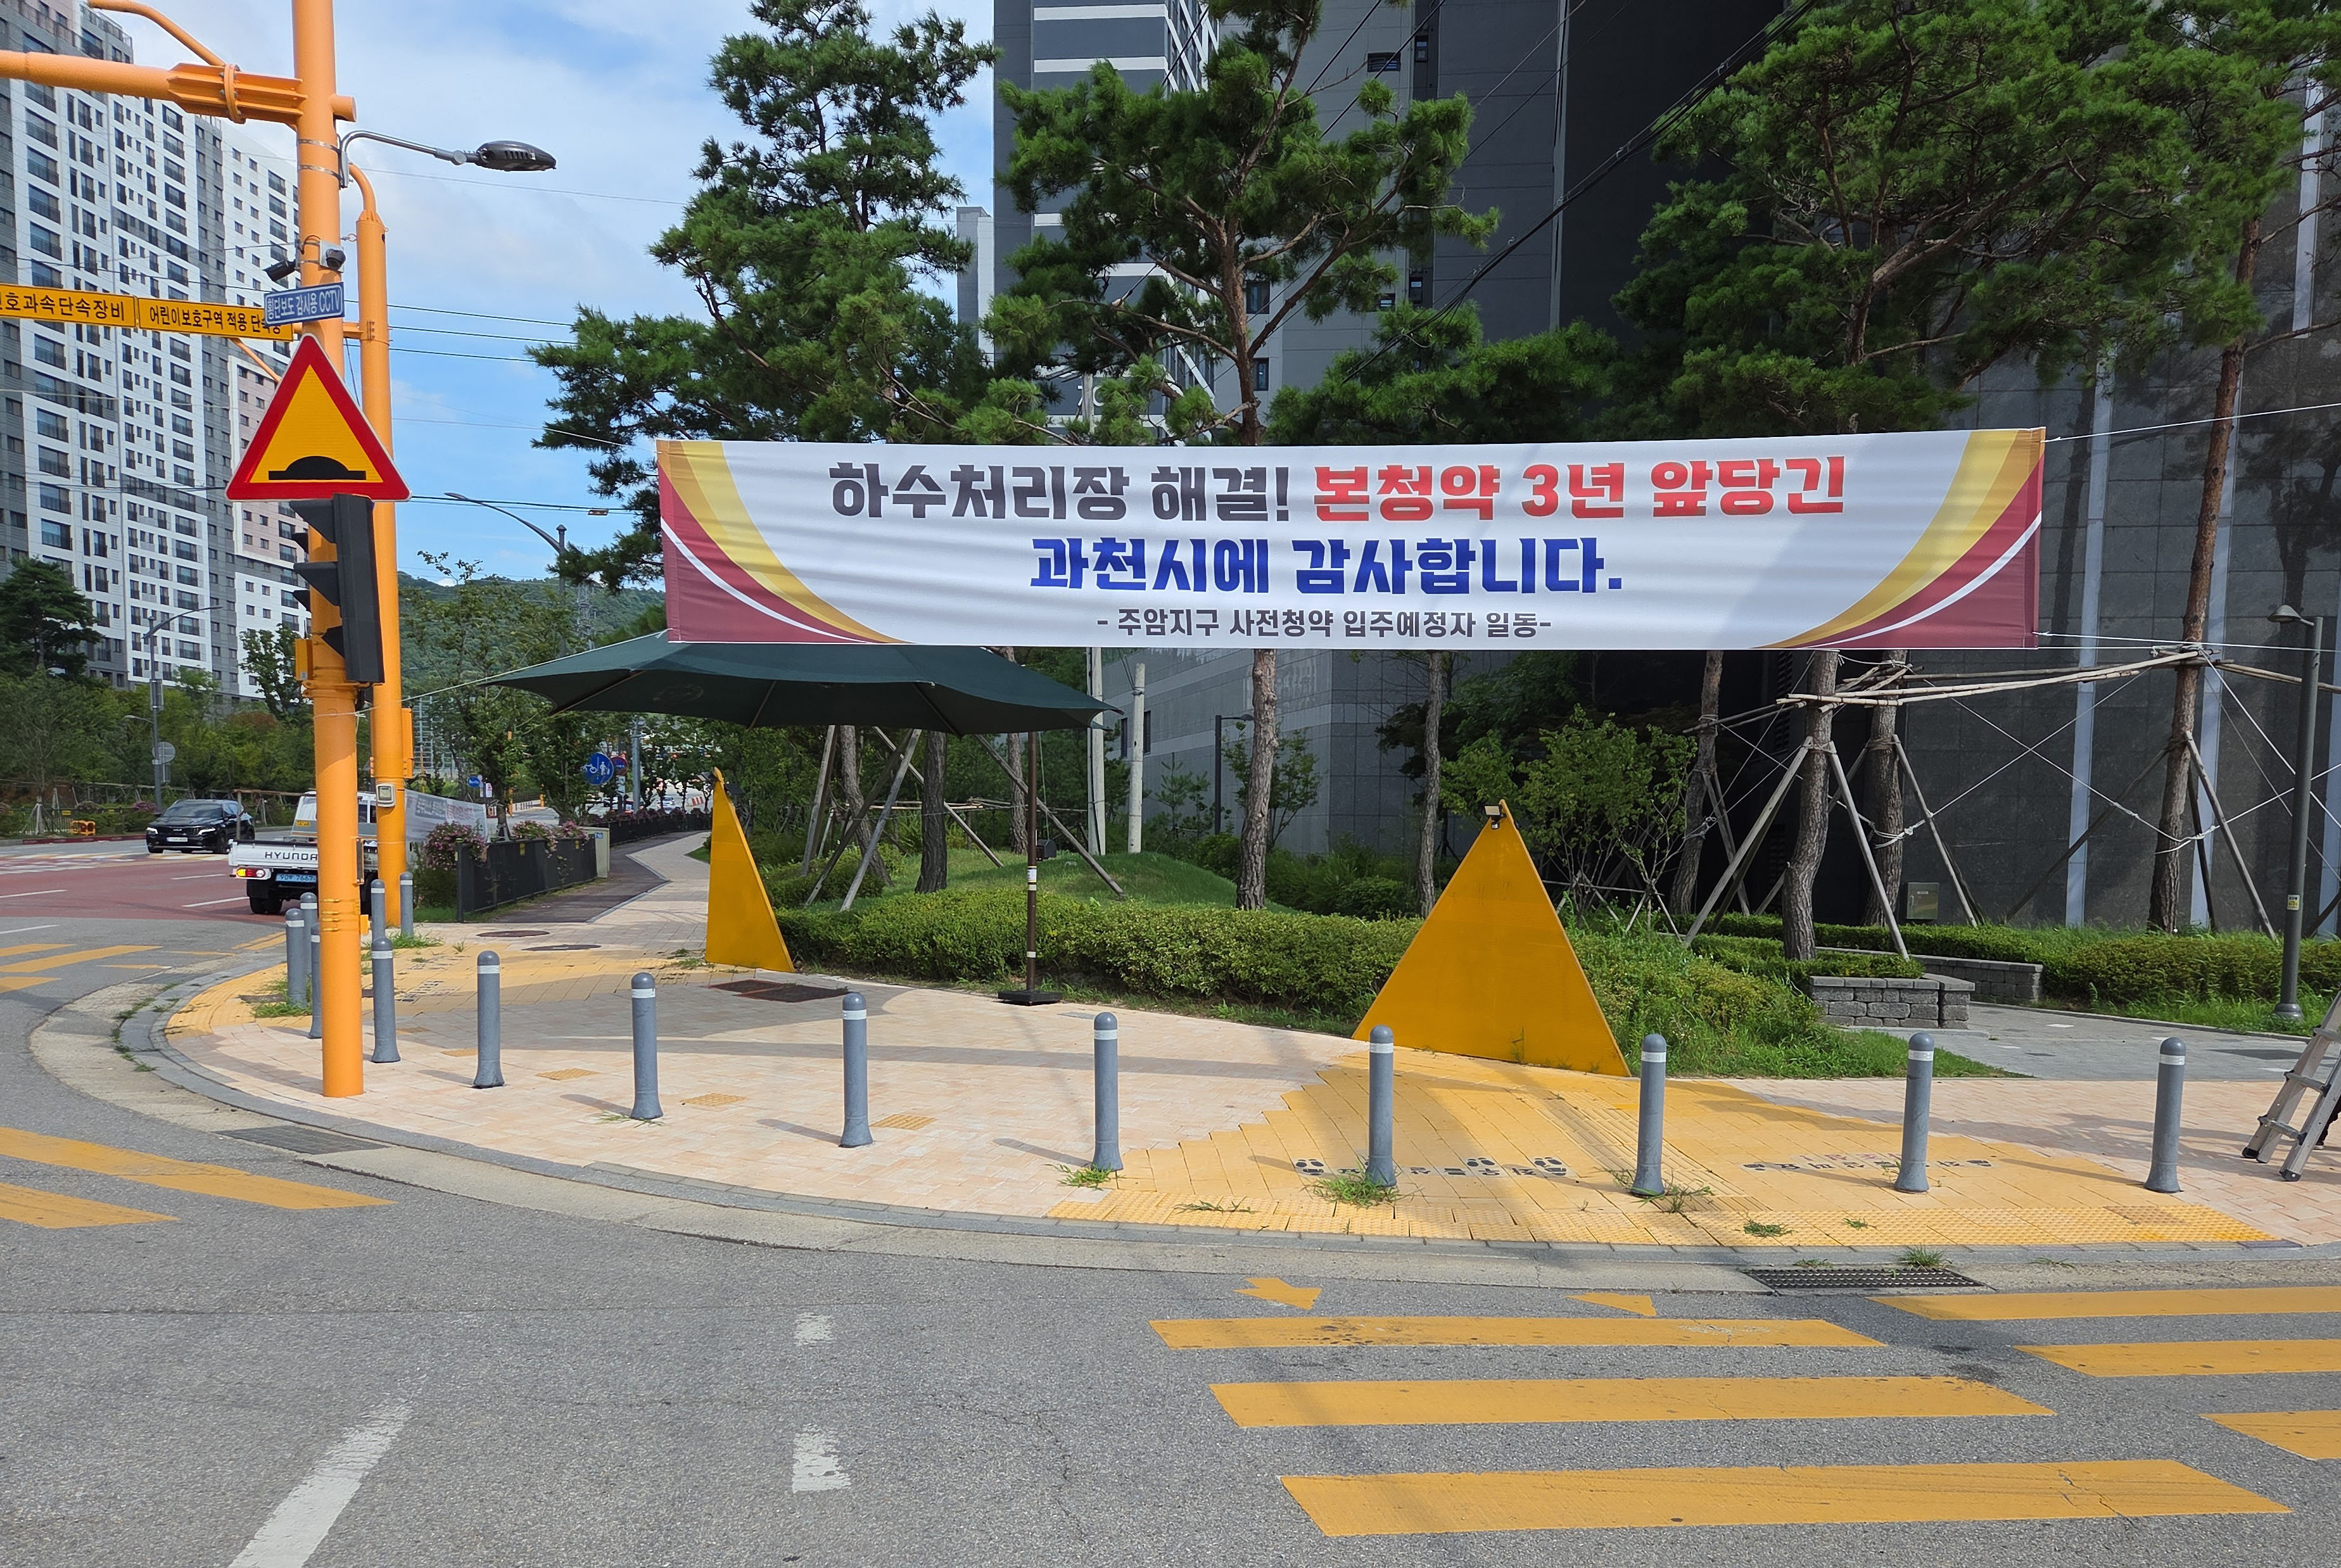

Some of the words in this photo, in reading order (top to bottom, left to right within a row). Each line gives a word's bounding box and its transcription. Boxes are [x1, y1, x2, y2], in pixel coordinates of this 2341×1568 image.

[0, 292, 125, 322] 호과속단속장비
[149, 305, 224, 330] 어린이보호구역
[227, 312, 248, 332] 적용
[267, 297, 295, 320] 횡단보도
[296, 293, 318, 316] 감시용
[319, 289, 340, 313] CCTV
[829, 462, 1129, 521] 하수처리장
[1151, 466, 1289, 522] 해결!
[1314, 465, 1500, 521] 본청약
[1522, 464, 1624, 519] 3년
[1651, 456, 1844, 517] 앞당긴
[1030, 537, 1269, 593] 과천시에
[1291, 537, 1622, 595] 감사합니다.
[1118, 609, 1219, 636] 주암지구
[1229, 609, 1333, 637] 사전청약
[1343, 611, 1476, 638] 입주예정자
[265, 851, 318, 861] HYUNDA
